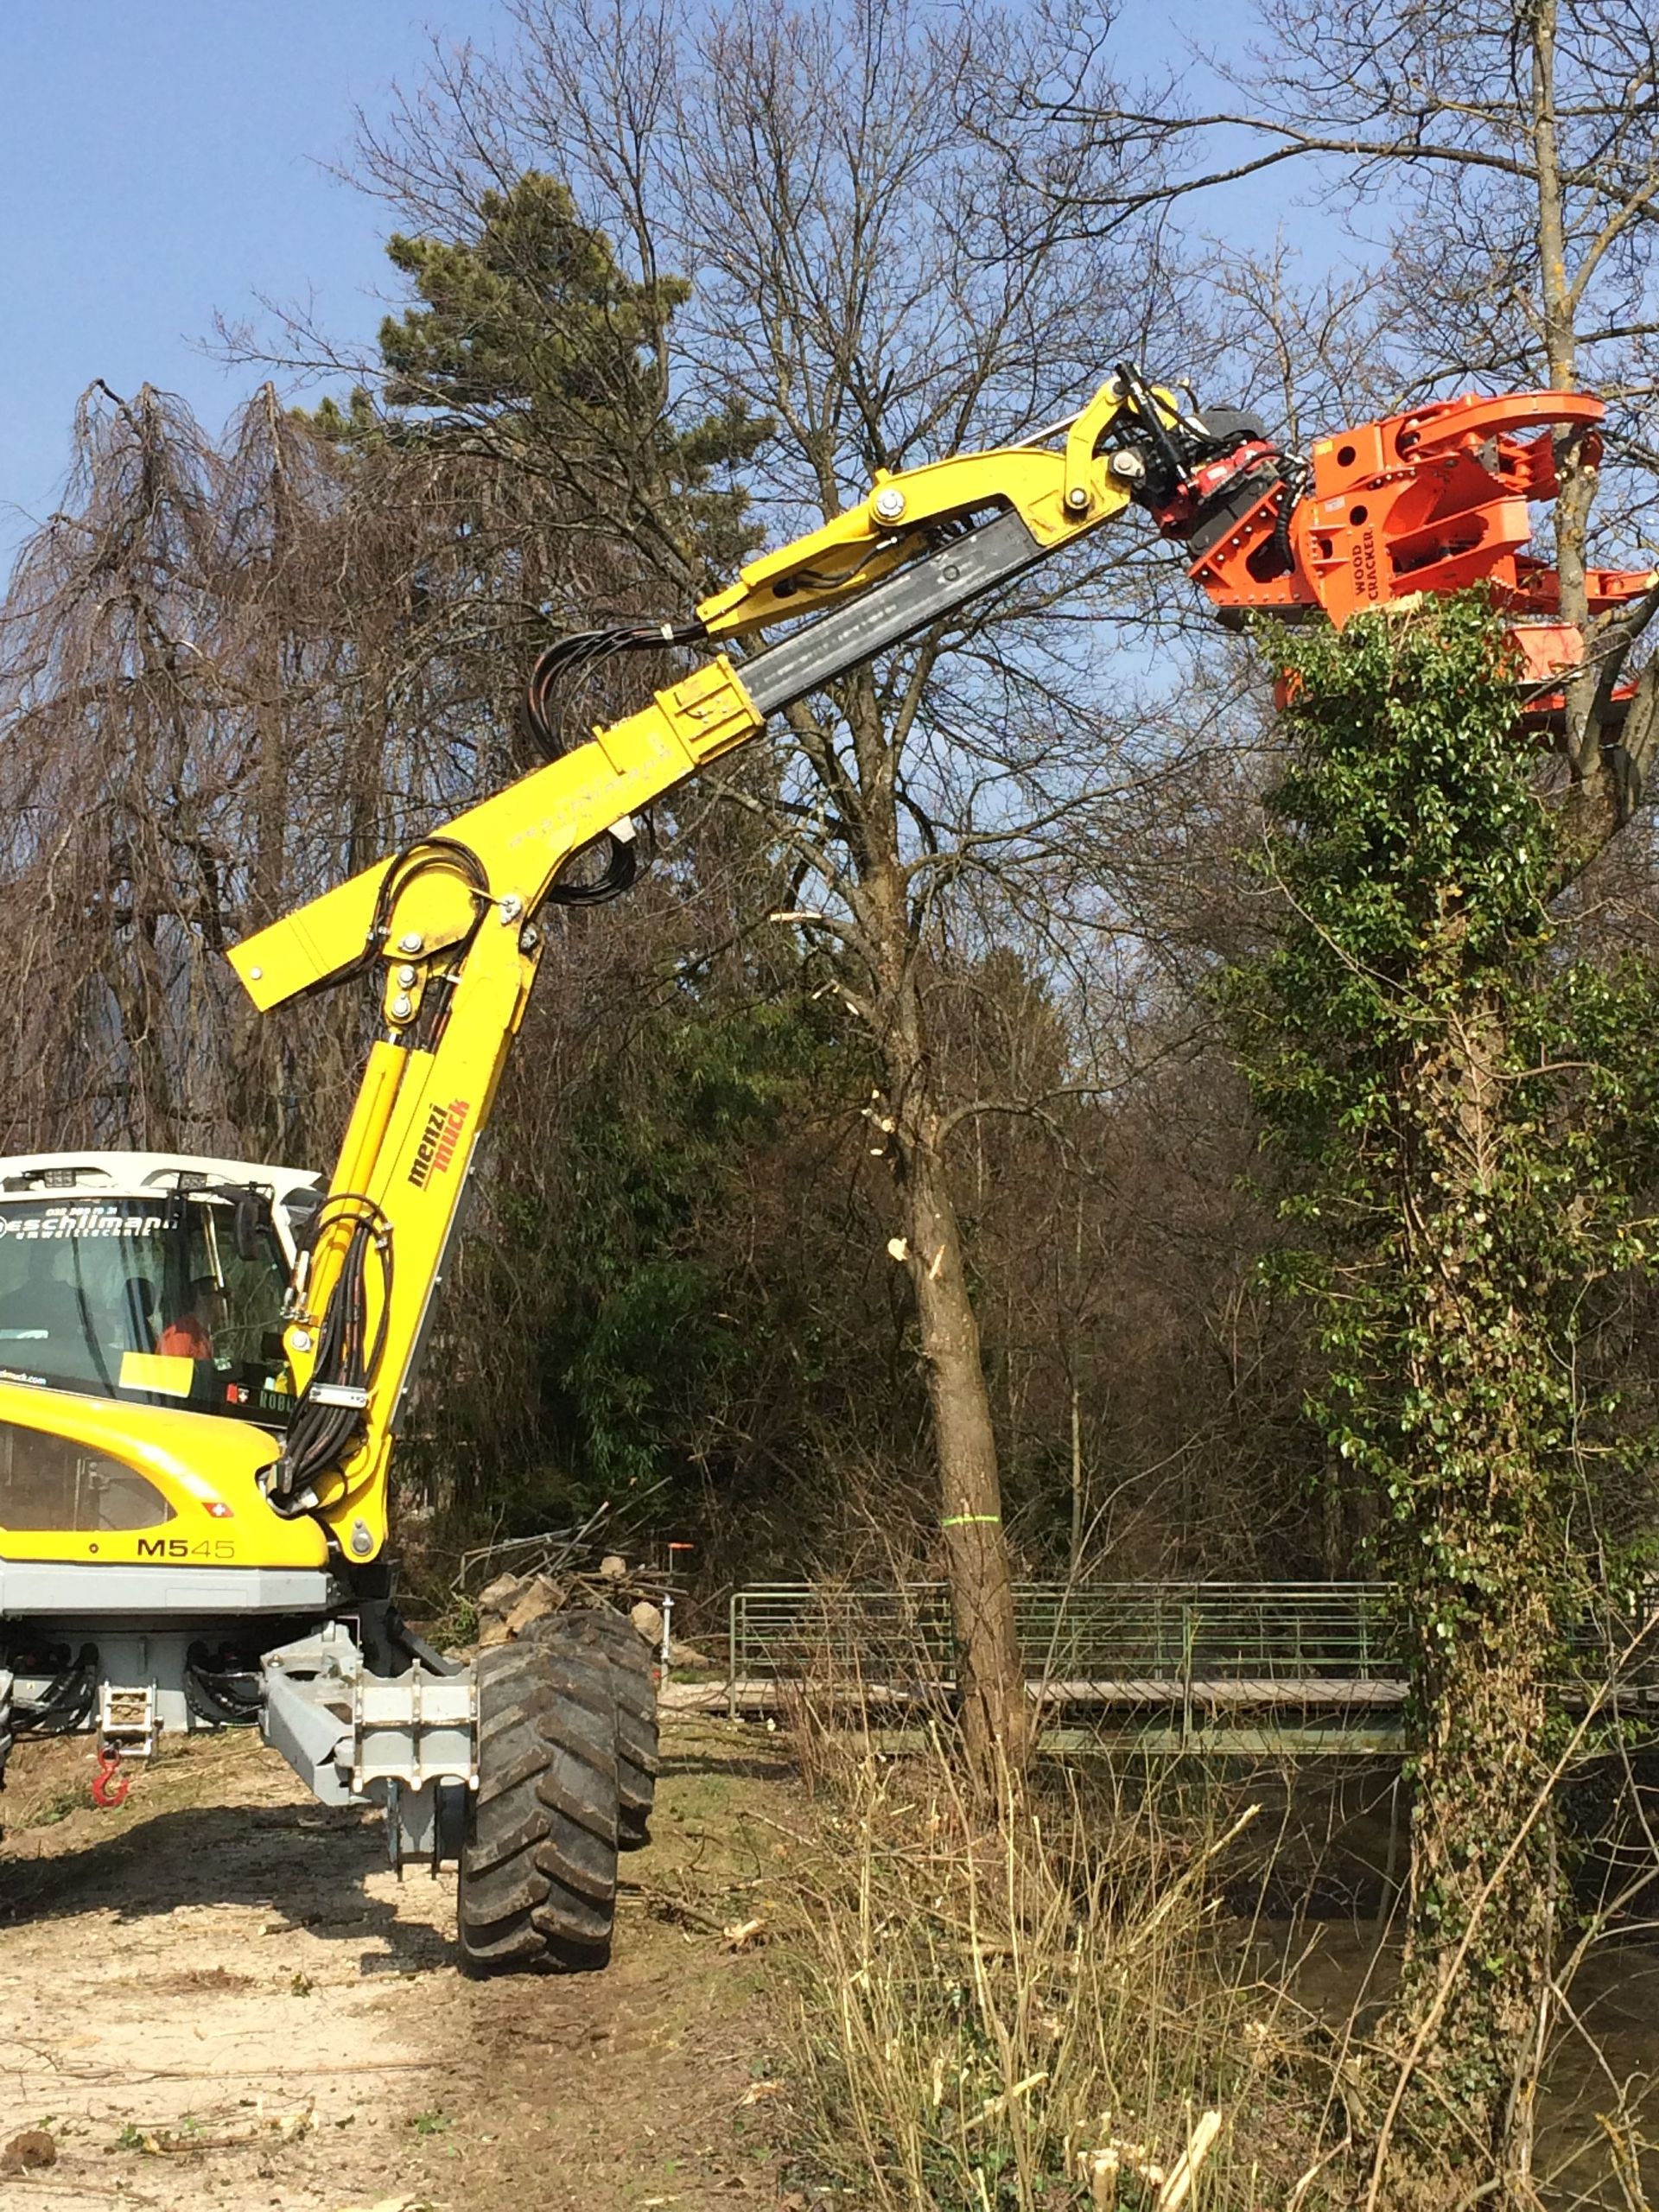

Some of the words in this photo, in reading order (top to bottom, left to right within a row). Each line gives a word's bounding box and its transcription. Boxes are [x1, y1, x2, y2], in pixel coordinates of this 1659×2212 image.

[1352, 544, 1365, 596] WOOD
[1363, 530, 1379, 601] CRACKER
[408, 1103, 448, 1188] menzi
[434, 1098, 470, 1173] muck
[0, 1215, 179, 1236] eschlimann
[137, 1538, 235, 1559] M545
